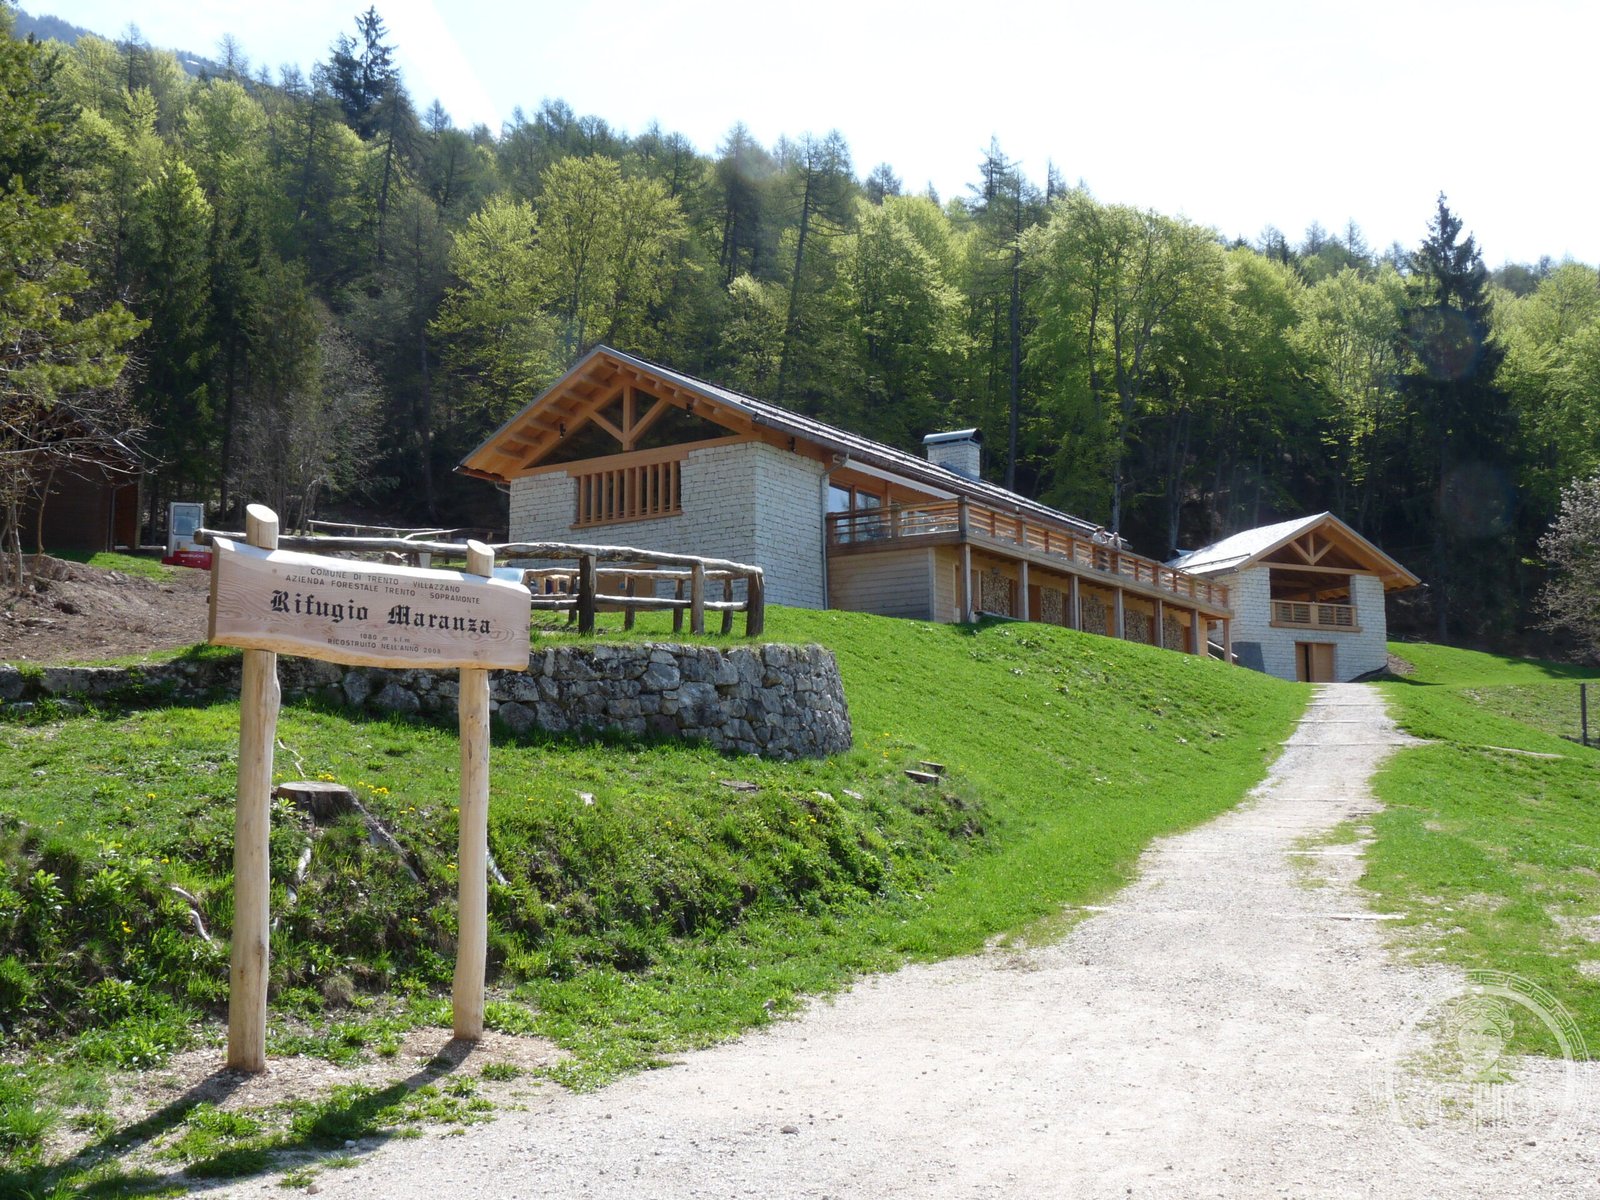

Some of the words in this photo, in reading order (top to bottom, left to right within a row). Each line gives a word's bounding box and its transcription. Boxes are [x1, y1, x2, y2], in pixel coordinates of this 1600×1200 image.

[285, 574, 325, 586] AZIENDA
[331, 580, 379, 593] FORESTALE
[385, 586, 416, 597] TRENTO
[430, 592, 481, 605] SOPRAMONTE
[310, 567, 347, 579] COMUNE
[367, 575, 399, 585] TRENTO
[413, 581, 461, 593] VILLAZZANO
[270, 589, 369, 624] Rifugio
[387, 604, 491, 634] Maranza
[327, 638, 377, 649] RICOSTRUITO
